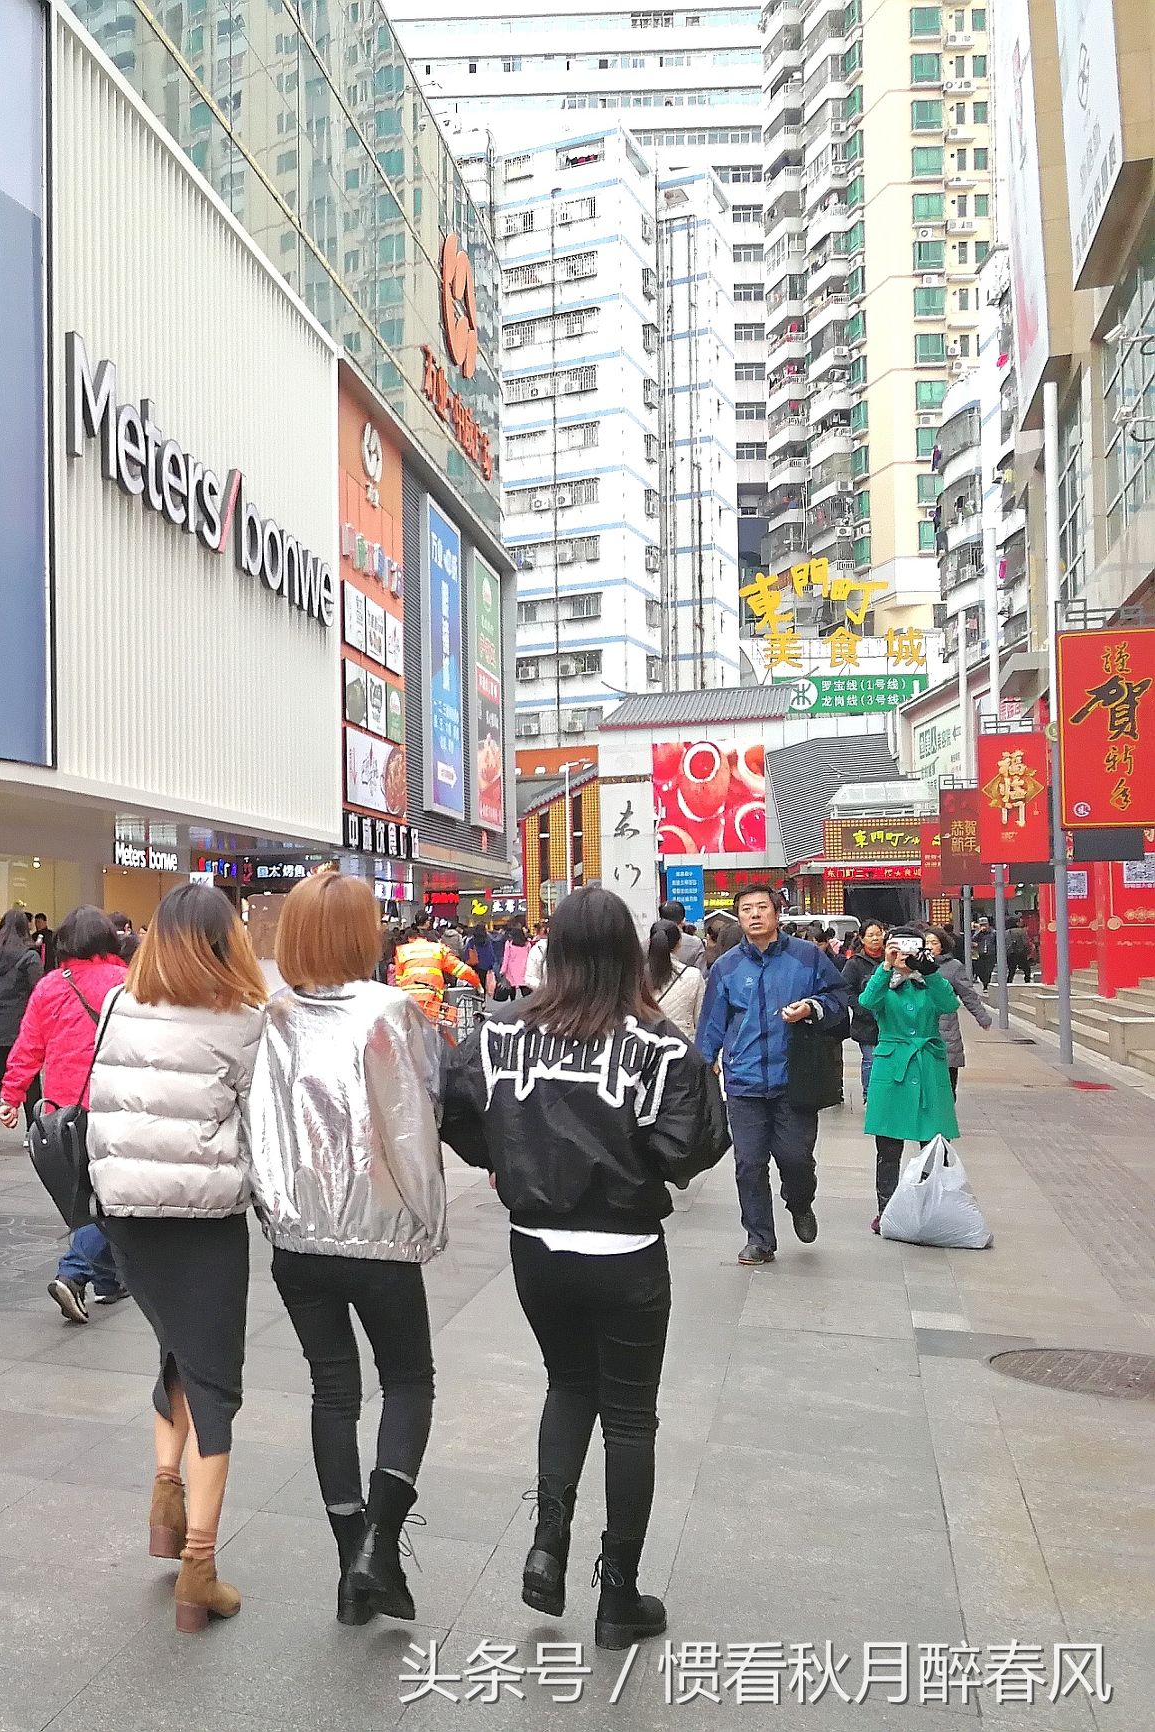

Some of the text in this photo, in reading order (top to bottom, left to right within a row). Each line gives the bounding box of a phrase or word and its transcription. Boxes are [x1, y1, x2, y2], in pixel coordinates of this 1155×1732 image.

[65, 331, 334, 627] Meters/bonwe
[763, 626, 926, 669] 美食城
